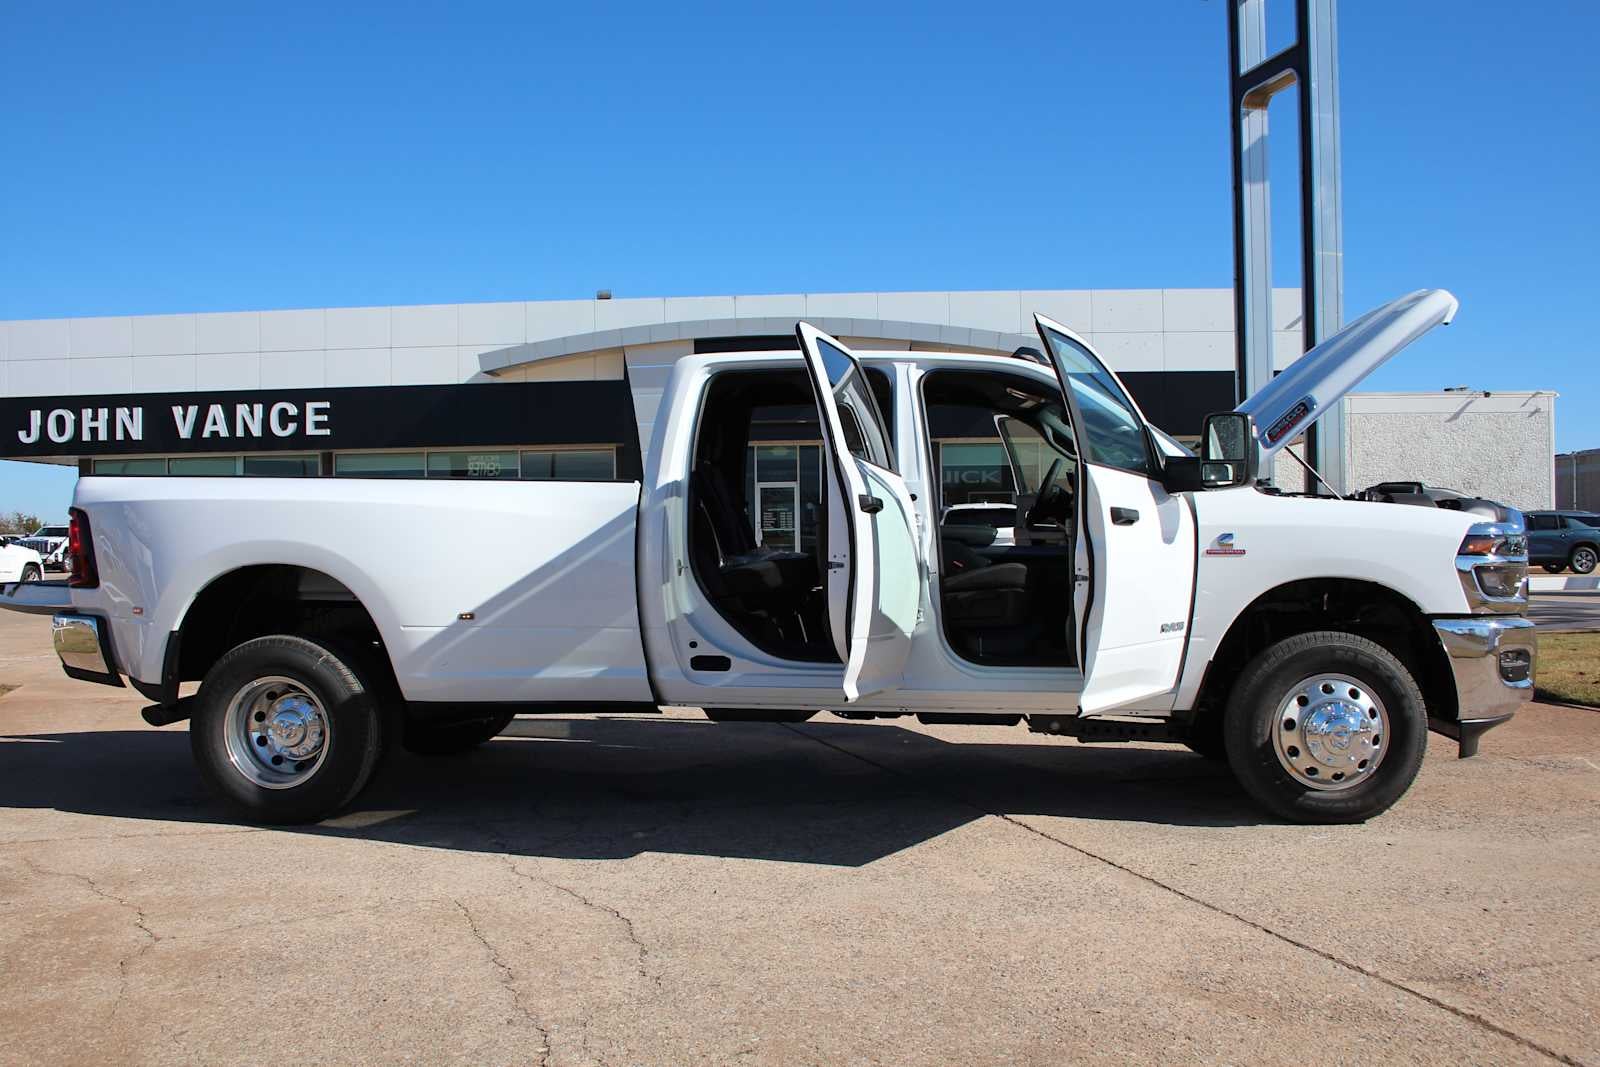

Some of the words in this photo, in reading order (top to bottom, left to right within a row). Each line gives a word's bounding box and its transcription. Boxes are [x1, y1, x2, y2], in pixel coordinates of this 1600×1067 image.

[18, 407, 143, 443] JOHN
[172, 401, 331, 439] VANCE
[943, 470, 1001, 484] UICK
